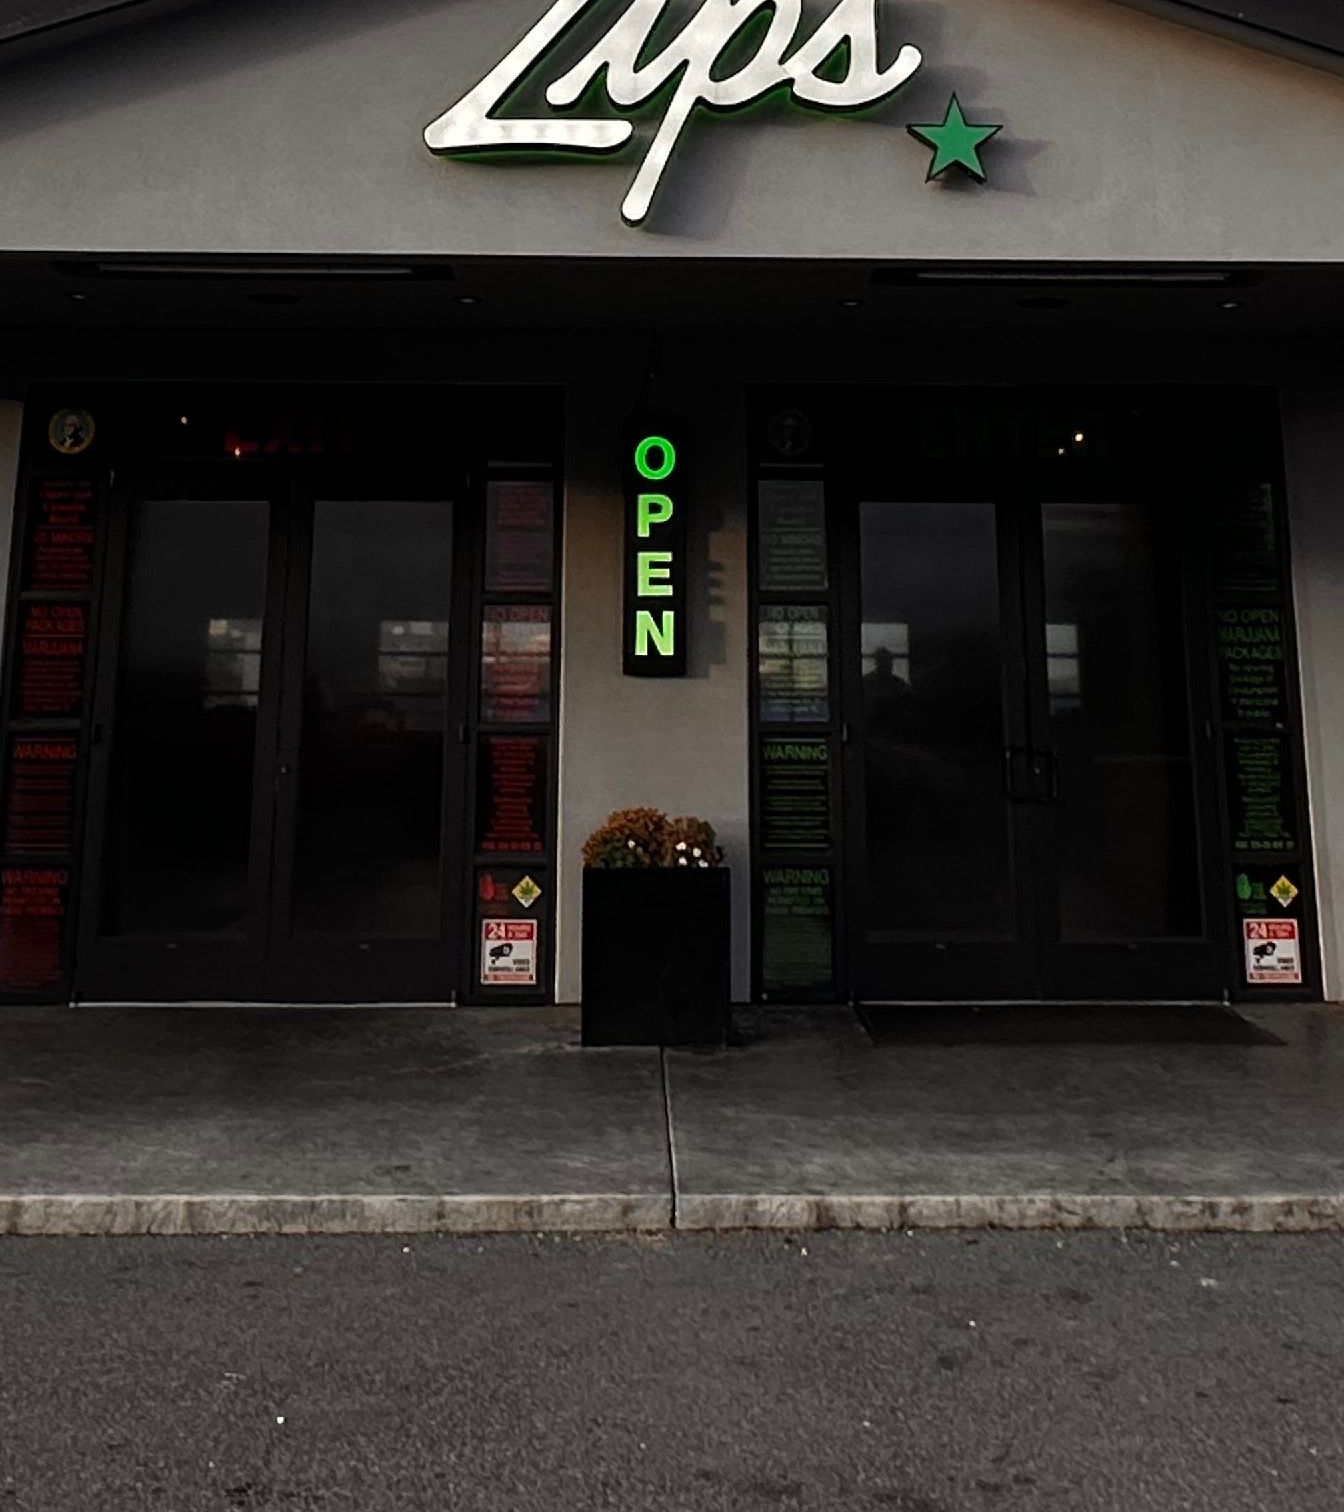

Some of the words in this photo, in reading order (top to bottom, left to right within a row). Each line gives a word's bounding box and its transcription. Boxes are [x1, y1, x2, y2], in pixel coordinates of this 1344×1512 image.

[635, 436, 676, 656] OPEN
[14, 743, 77, 760] WARNING
[763, 743, 829, 760] WARNING
[762, 868, 830, 885] WARNING
[1248, 922, 1267, 939] 24
